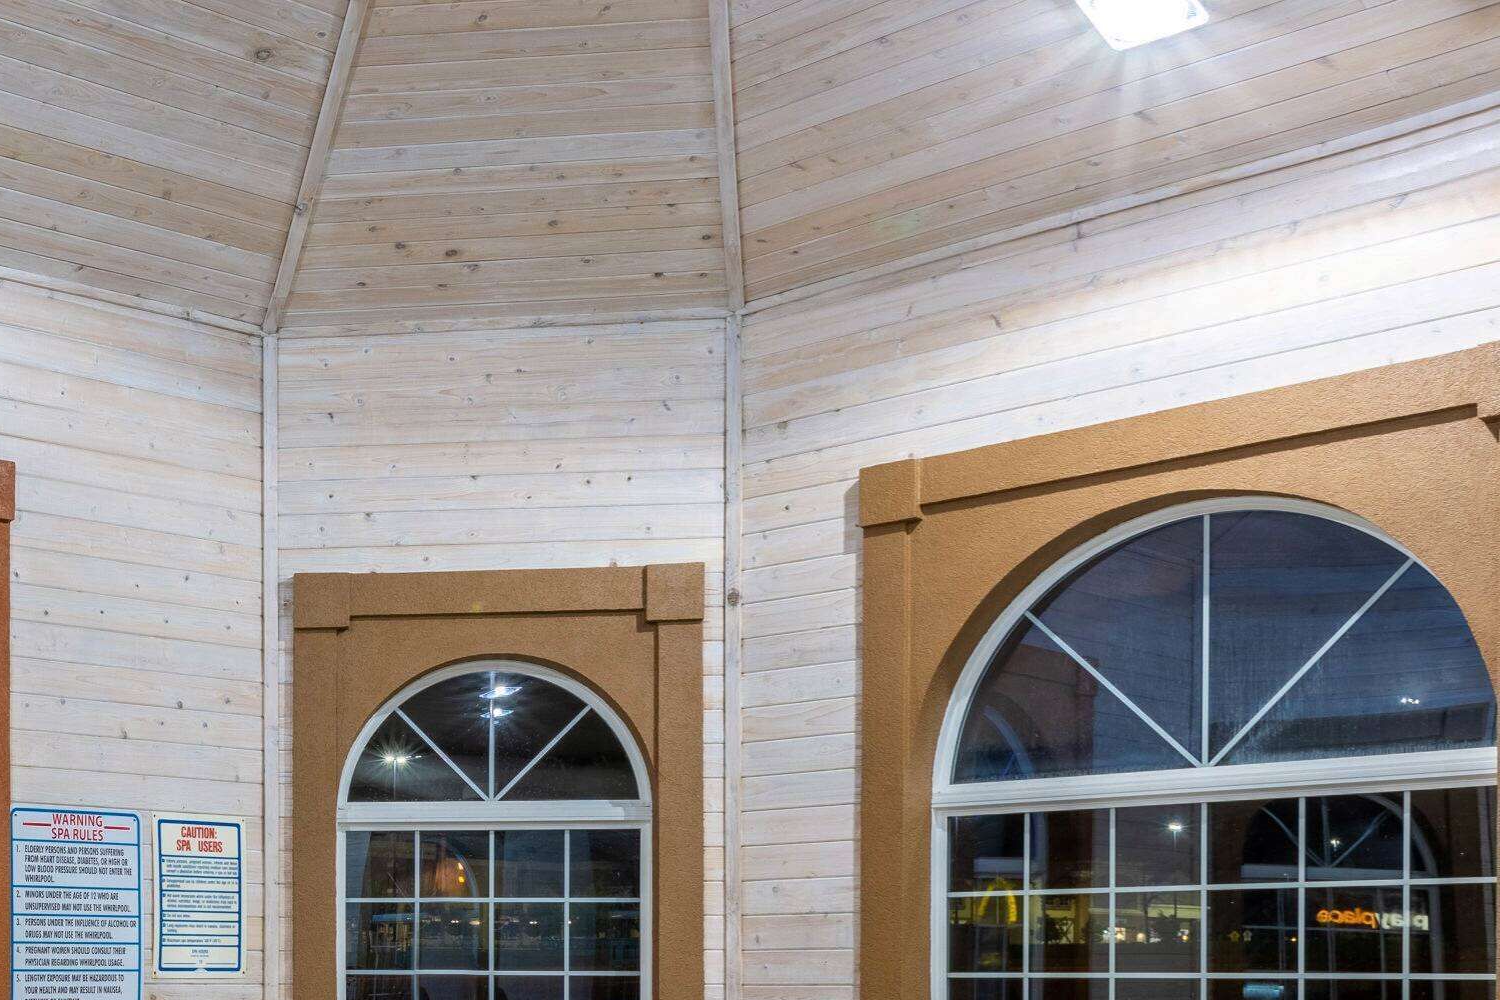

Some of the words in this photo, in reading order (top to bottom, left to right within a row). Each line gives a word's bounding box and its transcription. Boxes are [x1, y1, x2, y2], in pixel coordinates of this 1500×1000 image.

[52, 814, 103, 827] WARNING
[51, 828, 70, 839] SPA
[73, 829, 104, 841] RULES
[181, 826, 217, 839] CAUTION:
[25, 845, 44, 853] ELDERLY
[45, 845, 66, 854] PERSONS
[67, 846, 77, 854] AND
[78, 847, 99, 855] PERSONS
[100, 848, 124, 856] SUFFERING
[176, 840, 191, 851] SPA
[198, 841, 223, 852] USERS
[40, 855, 55, 863] HEART
[37, 865, 54, 873] BLOOD
[79, 867, 98, 875] SHOULD
[99, 867, 108, 875] NOT
[124, 868, 132, 876] THE
[25, 891, 44, 899] MINORS
[46, 891, 62, 899] UNDER
[73, 892, 82, 900] AGE
[83, 892, 90, 900] OF
[25, 903, 60, 911] UNSUPERVISED
[64, 919, 74, 927] THE
[75, 919, 100, 927] INFLUENCE
[25, 930, 42, 938] DRUGS
[65, 931, 73, 939] USE
[74, 931, 83, 939] THE
[72, 947, 90, 955] SHOULD
[91, 947, 112, 955] CONSULT
[113, 947, 126, 955] THEIR
[25, 974, 46, 982] LENGTHY
[47, 974, 70, 982] EXPOSURE
[71, 974, 82, 982] MAY
[90, 974, 117, 982] HAZARDOUS
[118, 974, 125, 982] TO
[25, 986, 38, 994] YOUR
[39, 986, 56, 994] HEALTH
[58, 986, 68, 994] AND
[69, 986, 79, 994] MAY
[80, 986, 96, 994] RESULT
